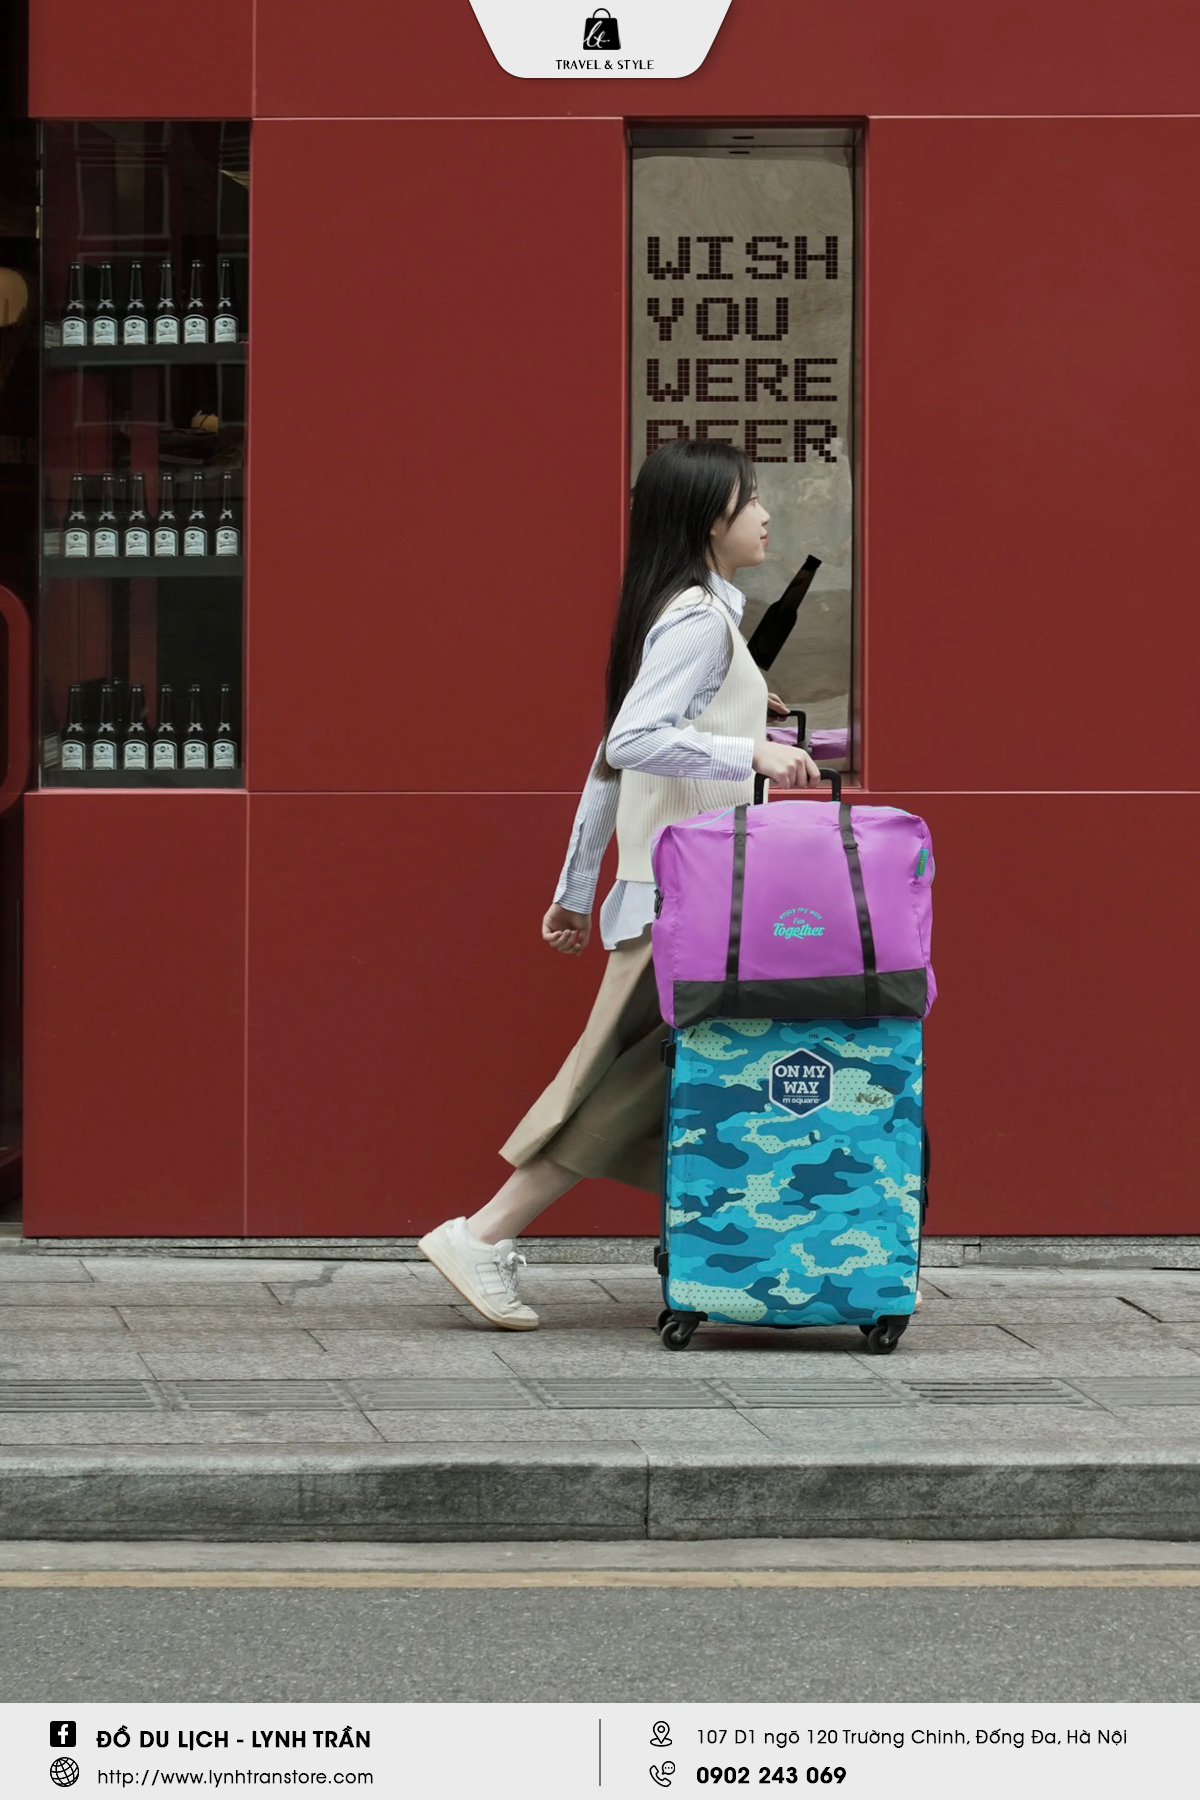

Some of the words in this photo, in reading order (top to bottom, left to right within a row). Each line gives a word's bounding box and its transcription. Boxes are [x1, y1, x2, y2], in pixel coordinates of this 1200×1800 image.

[647, 236, 838, 280] WISH
[647, 297, 789, 341] YOU
[646, 358, 838, 402] WERE
[779, 909, 796, 919] enjoy
[809, 909, 823, 919] way
[773, 922, 825, 940] Together
[774, 1065, 800, 1078] ON
[802, 1065, 827, 1078] MY
[783, 1081, 820, 1094] WAY
